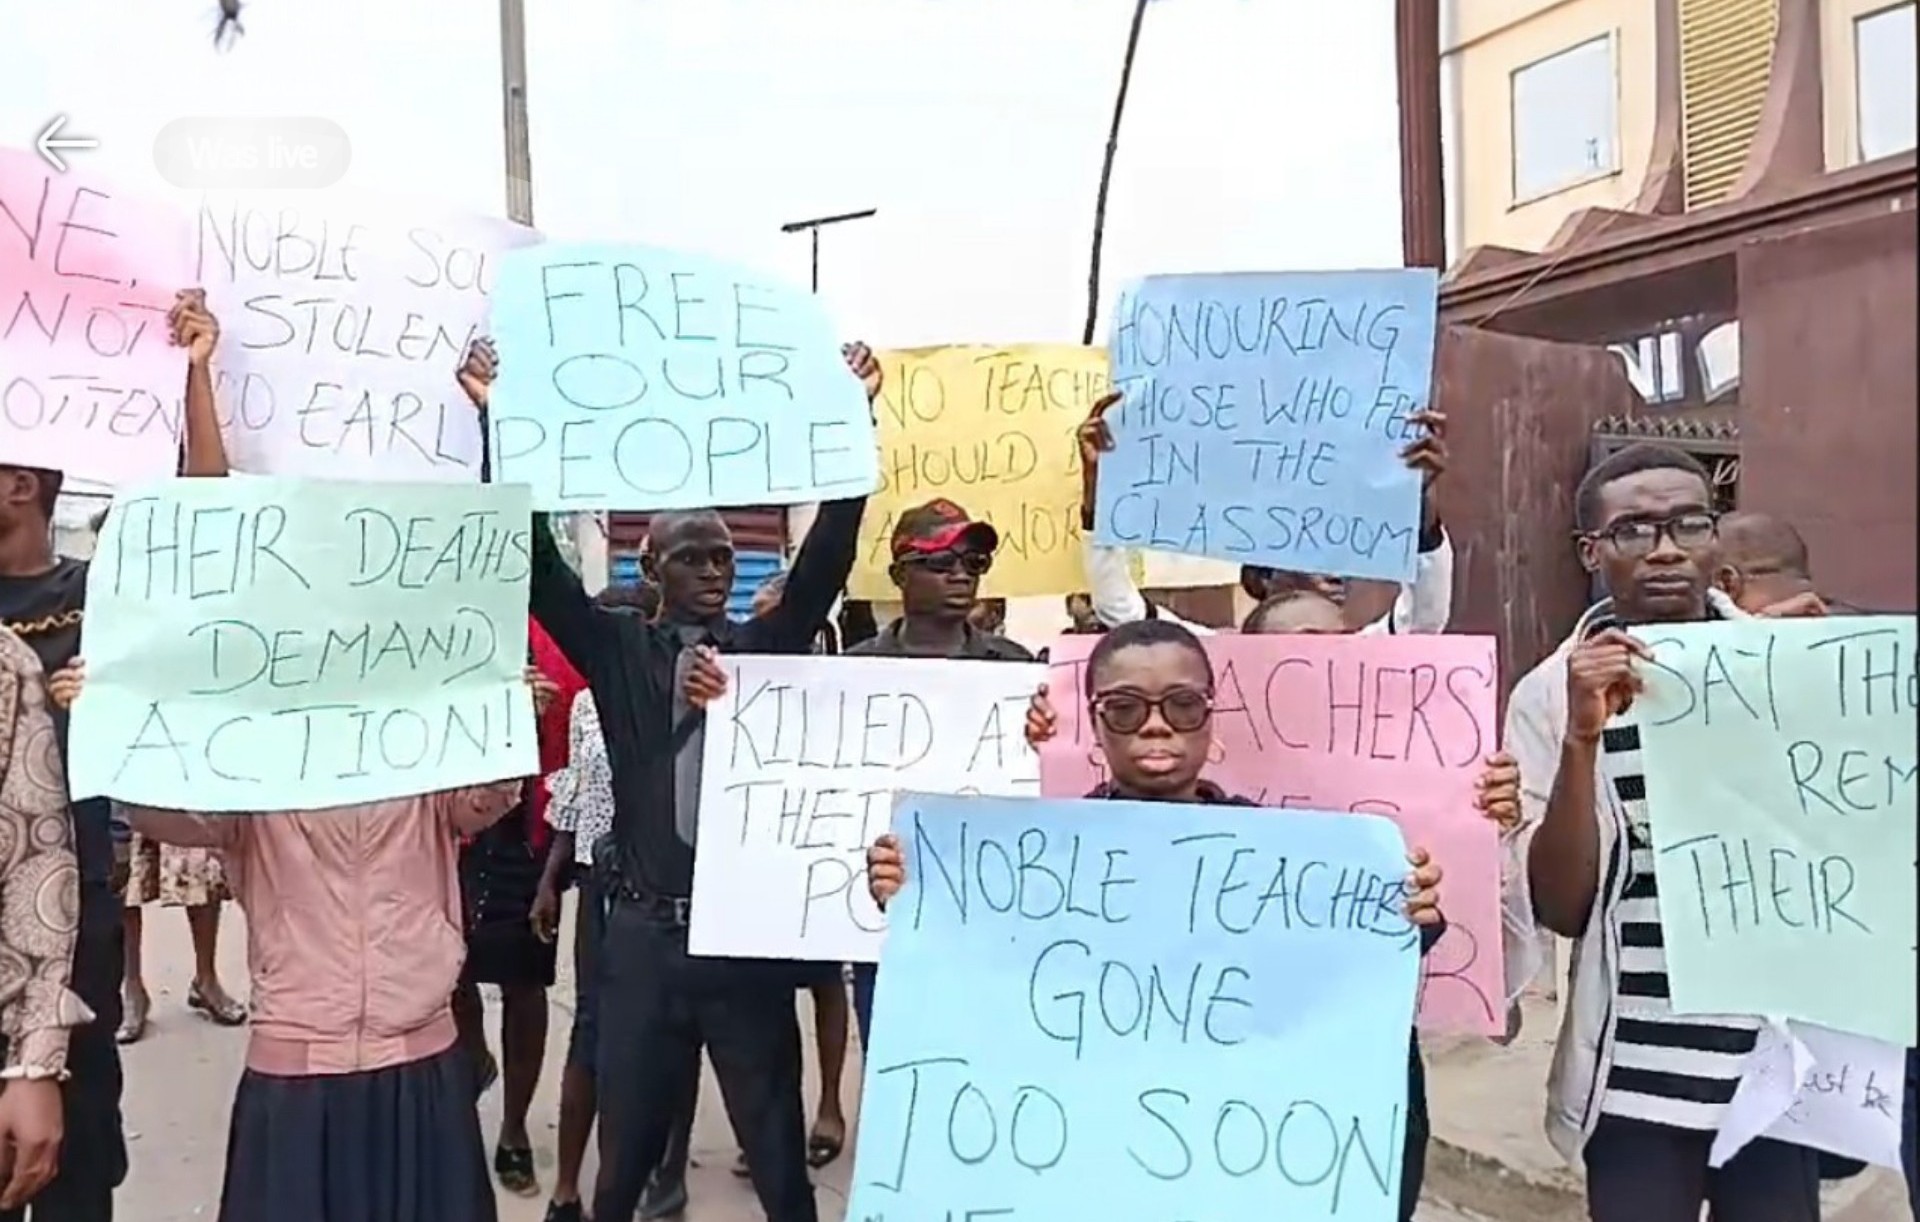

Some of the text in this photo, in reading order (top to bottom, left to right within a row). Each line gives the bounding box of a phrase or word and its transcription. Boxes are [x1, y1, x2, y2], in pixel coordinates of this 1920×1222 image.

[196, 191, 369, 284] NOBLE
[241, 293, 479, 362] STOLEN
[541, 260, 799, 351] FREE
[1113, 291, 1406, 384] HONOURING
[297, 382, 469, 466] EARL
[551, 350, 794, 411] OUR
[973, 351, 1111, 416] TEACHE
[1111, 374, 1239, 431] THOSE
[1259, 376, 1353, 426] WHO
[495, 416, 870, 500] PEOPLE
[1131, 433, 1200, 489] IN
[1232, 437, 1336, 487] THE
[113, 497, 530, 601] THEIR DEATHS
[985, 501, 1083, 562] WOR
[1109, 493, 1414, 568] CLASSROOM
[187, 607, 497, 696] DEMAND
[1648, 632, 1781, 732] SAY
[111, 688, 514, 784] ACTION!
[730, 665, 934, 771] KILLED
[1050, 650, 1497, 769] TACHERS'
[723, 779, 890, 853] THEI
[912, 811, 1137, 931] NOBLE
[1659, 832, 1873, 939] THEIR
[1028, 938, 1254, 1060] GONE
[869, 1057, 1399, 1214] TOO SOON
